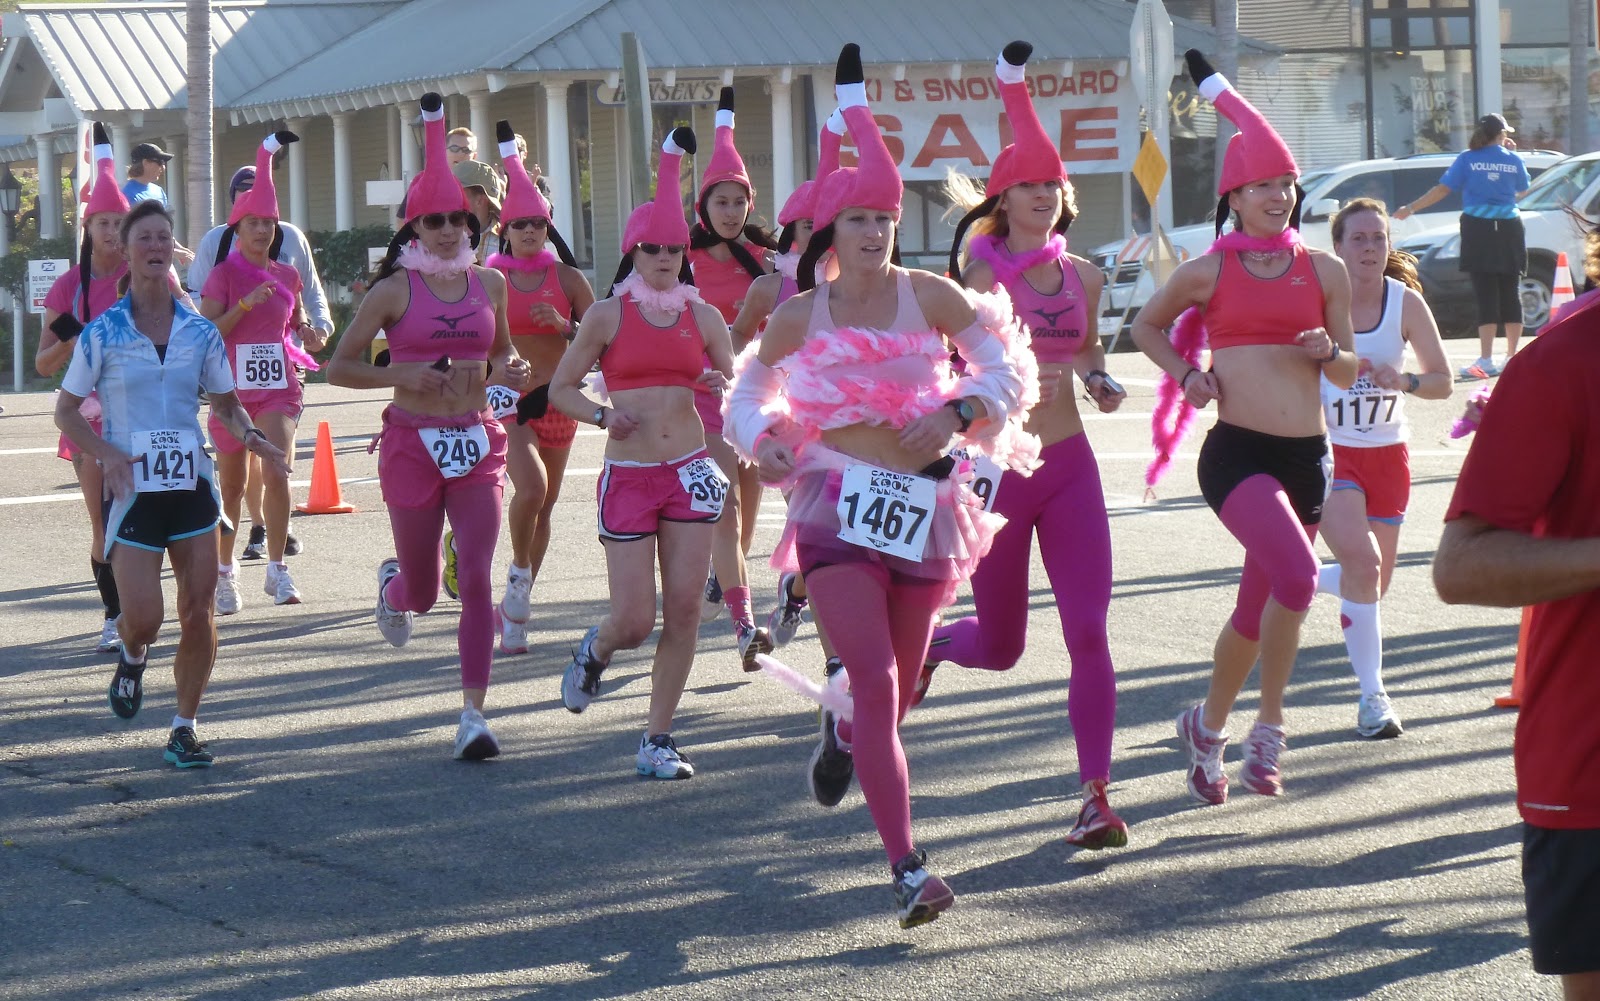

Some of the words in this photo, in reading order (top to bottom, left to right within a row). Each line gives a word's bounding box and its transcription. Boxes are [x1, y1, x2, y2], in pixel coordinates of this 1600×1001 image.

[895, 79, 915, 102] &
[1470, 162, 1518, 173] VOLUNTEER
[245, 359, 283, 382] 589
[1332, 395, 1397, 426] 1177
[150, 436, 180, 444] KOOK
[433, 439, 481, 468] 249
[140, 450, 194, 482] 1421
[871, 470, 915, 482] CARDIFF
[868, 486, 891, 496] RUN
[869, 476, 912, 494] KOOK
[844, 491, 929, 546] 1467
